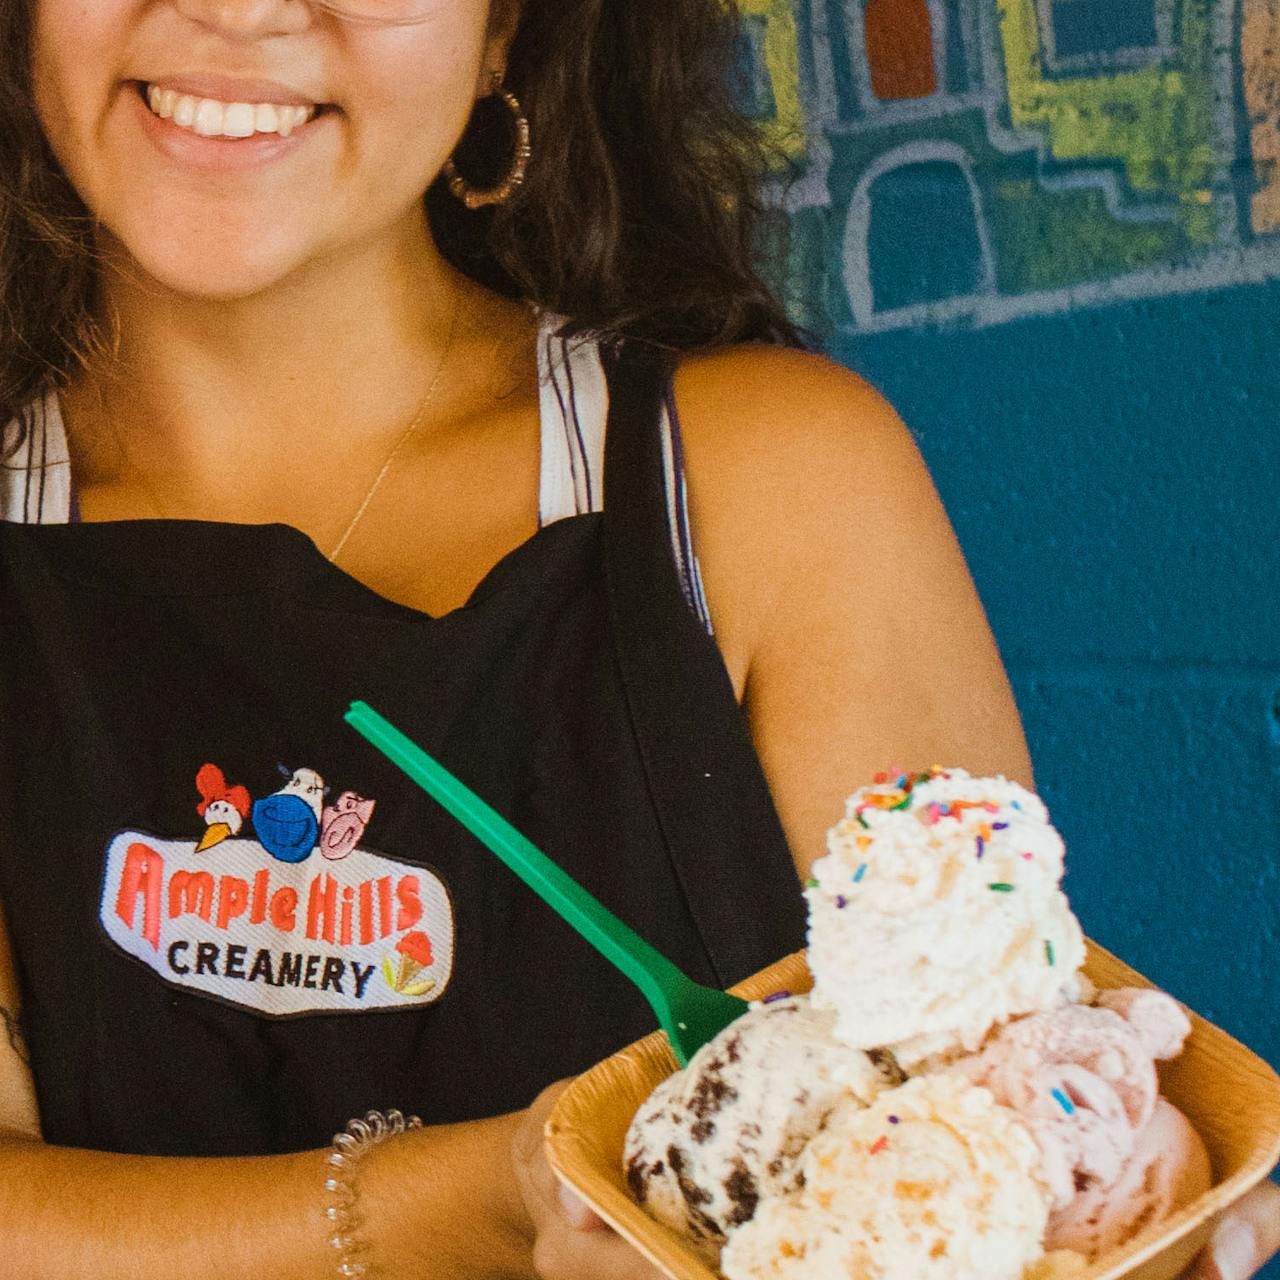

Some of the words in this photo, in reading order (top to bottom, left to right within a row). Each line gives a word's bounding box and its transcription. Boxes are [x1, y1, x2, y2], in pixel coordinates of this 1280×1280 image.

[115, 841, 299, 953] Ample
[305, 871, 425, 946] Hills
[167, 940, 376, 999] CREAMERY
